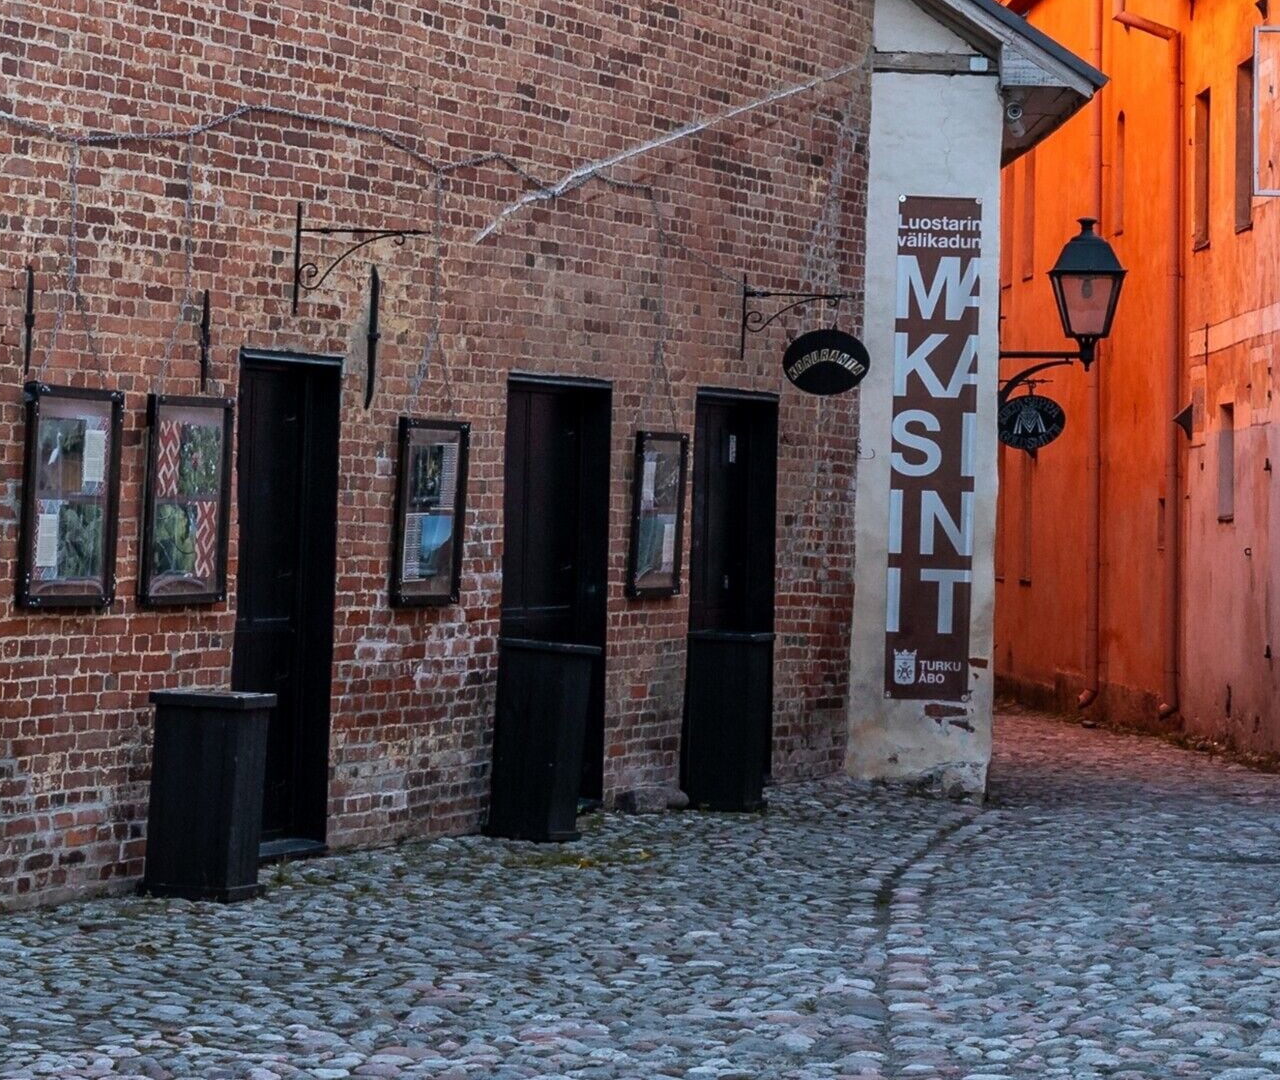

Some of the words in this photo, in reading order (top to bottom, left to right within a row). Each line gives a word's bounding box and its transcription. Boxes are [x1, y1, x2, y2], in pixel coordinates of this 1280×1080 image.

[898, 214, 982, 231] Luostarin
[897, 232, 982, 249] välikadun
[919, 660, 962, 672] TURKU
[918, 670, 945, 684] ÅBO
